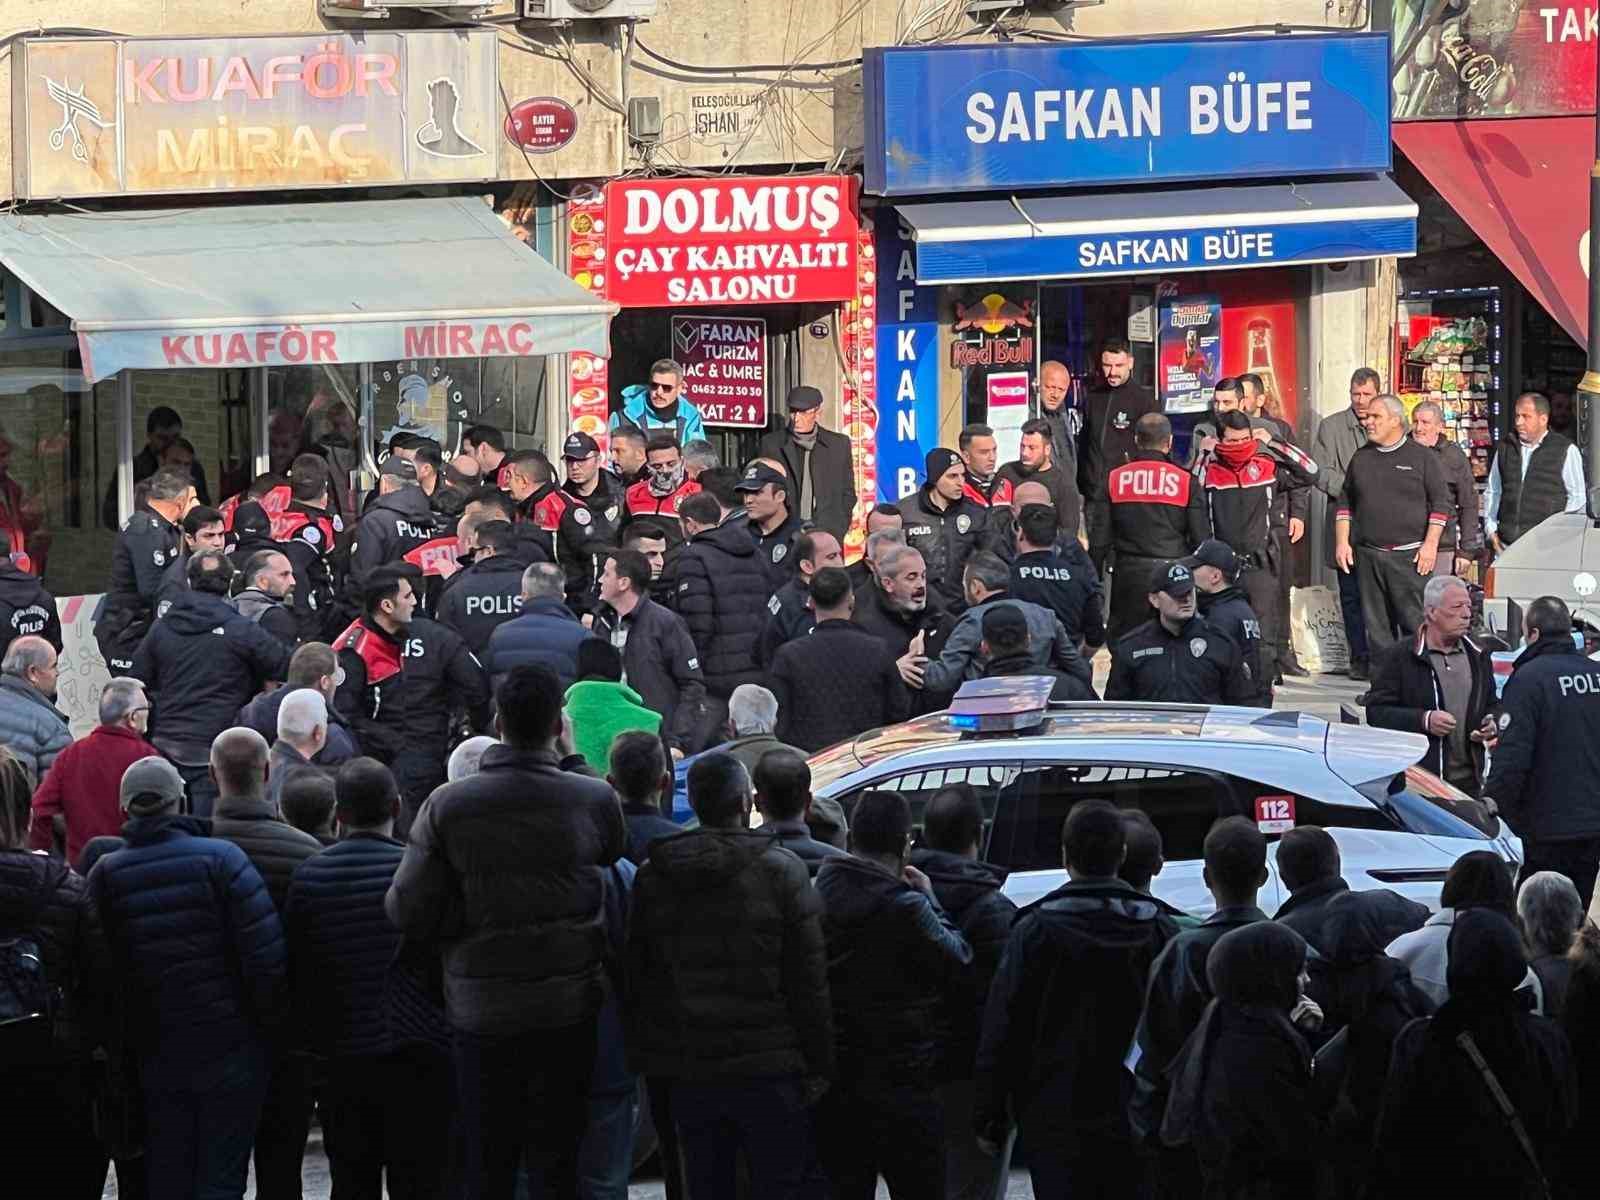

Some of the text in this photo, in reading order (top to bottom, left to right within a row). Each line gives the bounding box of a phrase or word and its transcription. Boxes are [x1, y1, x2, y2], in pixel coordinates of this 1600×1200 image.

[125, 42, 399, 104] KUAFÖR
[695, 109, 740, 137] İŞHANI
[966, 71, 1312, 144] SAFKAN BÜFE
[156, 116, 372, 179] MİRAÇ
[623, 185, 841, 238] DOLMUŞ
[615, 242, 848, 279] ÇAY KAHVALTI
[1078, 231, 1273, 268] SAFKAN BÜFE
[668, 274, 797, 303] SALONU
[161, 320, 536, 367] KUAFÖR MİRAÇ
[700, 323, 760, 343] FARAN
[952, 336, 1034, 369] Red Bull
[708, 362, 719, 379] &
[722, 363, 763, 381] UMRE
[691, 383, 763, 397] 0462 222 30 30
[696, 402, 726, 420] KAT
[1118, 466, 1180, 497] POLİS
[1260, 800, 1290, 819] 112
